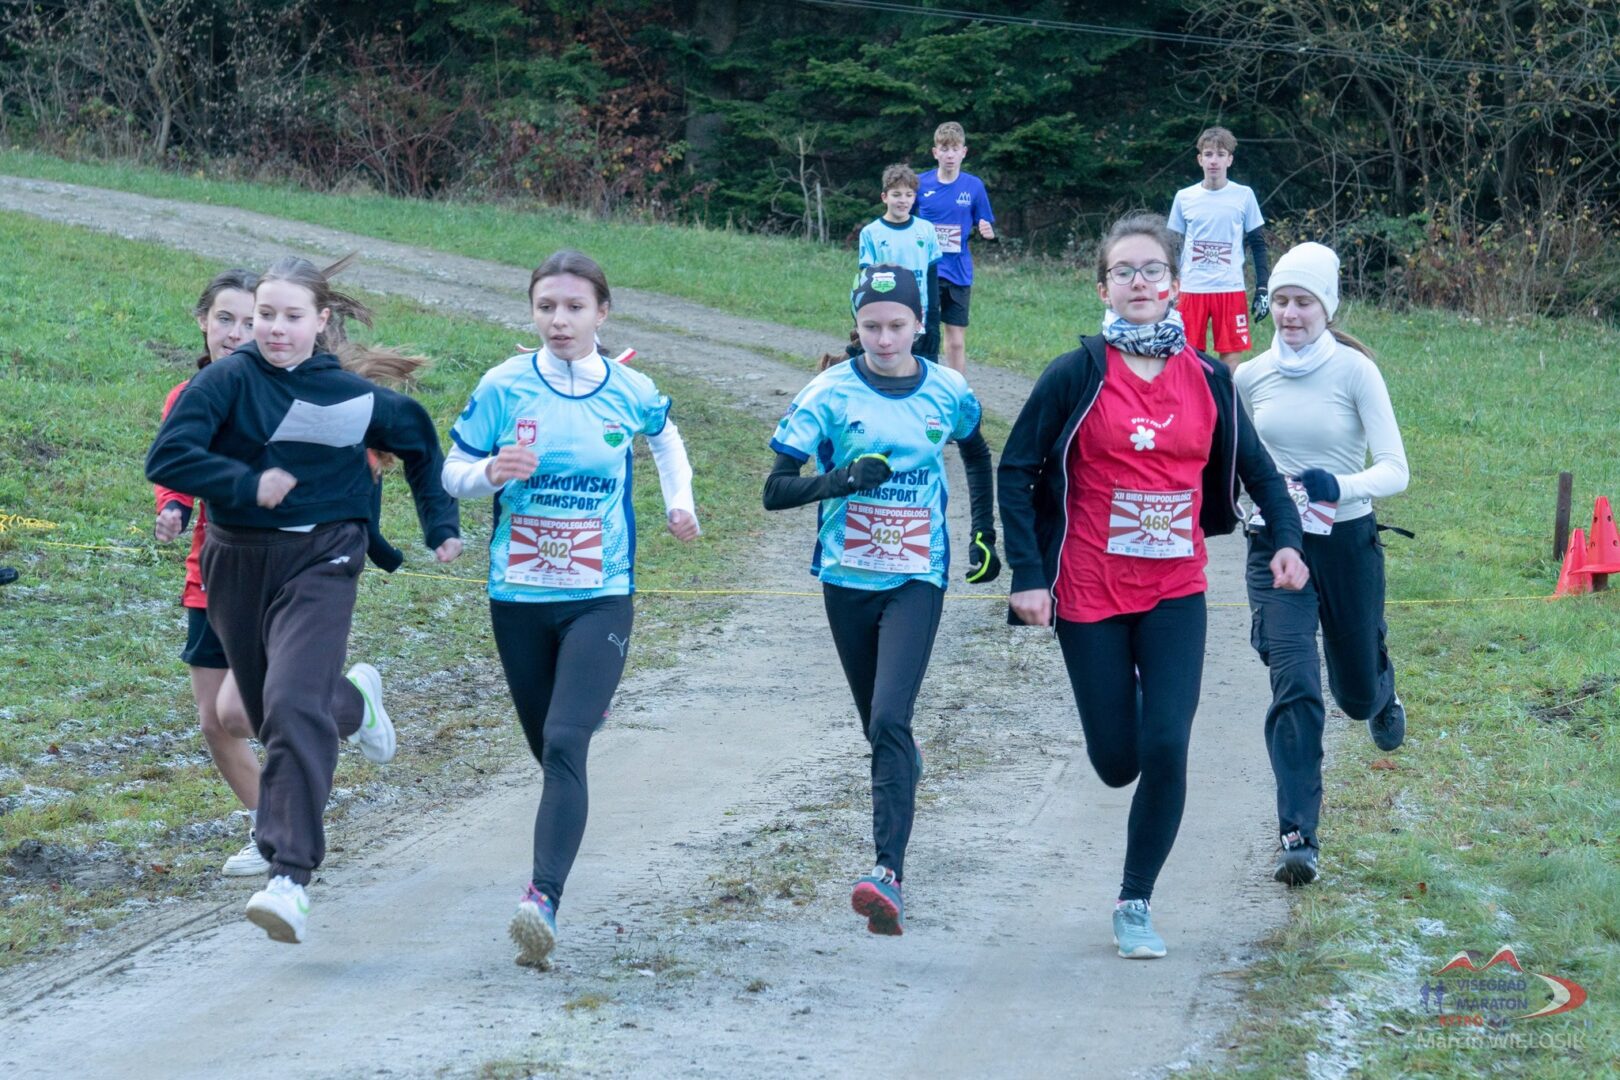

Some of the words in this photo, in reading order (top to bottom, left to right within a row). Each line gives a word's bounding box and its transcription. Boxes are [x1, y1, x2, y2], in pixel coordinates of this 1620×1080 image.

[530, 493, 601, 511] TRANSPORT
[1114, 492, 1125, 500] XII
[1126, 493, 1142, 501] BIEG
[849, 503, 858, 512] XII
[859, 505, 874, 513] BIEG
[523, 517, 539, 527] BIEG
[1143, 514, 1170, 531] 468
[873, 528, 901, 545] 429
[540, 540, 568, 559] 402
